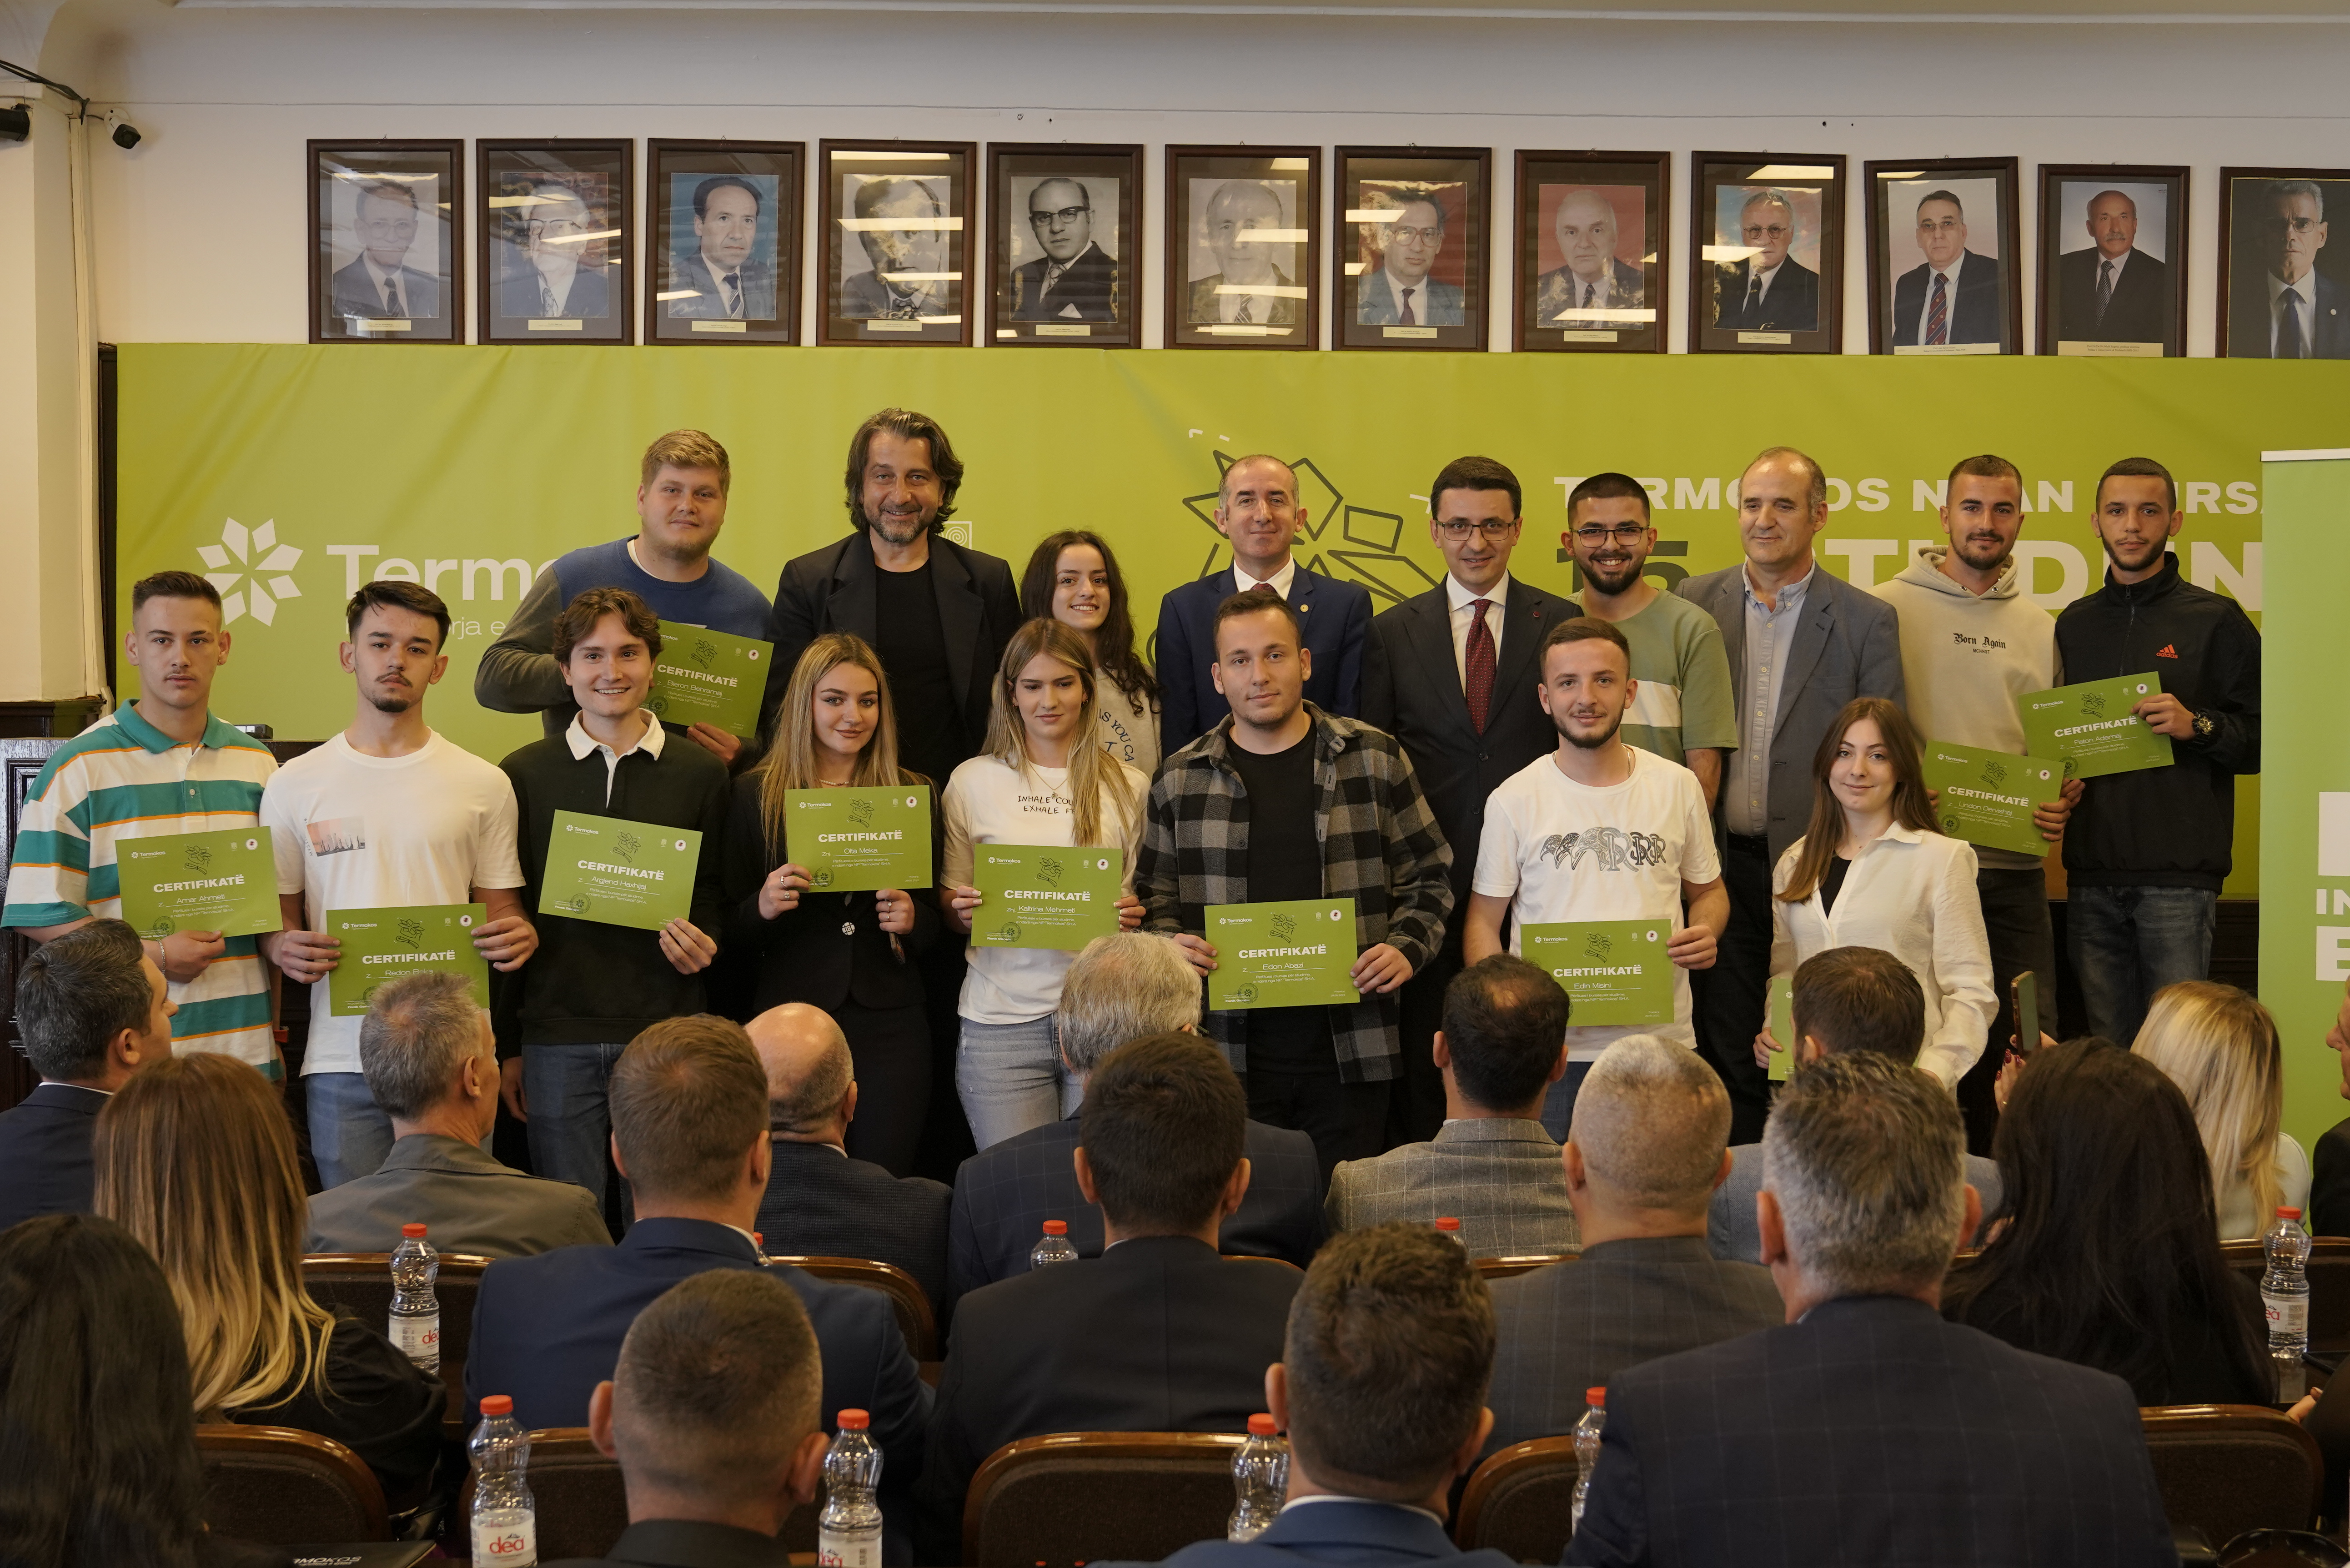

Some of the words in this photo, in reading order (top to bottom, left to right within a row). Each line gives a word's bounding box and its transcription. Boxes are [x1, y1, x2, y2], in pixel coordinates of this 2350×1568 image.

[1953, 633, 1976, 644] Born
[1982, 636, 2006, 649] Again
[657, 664, 738, 687] CERTIFIKATË
[690, 684, 723, 697] Behramaj
[2054, 715, 2137, 737] CERTIFIKATË
[1111, 720, 1131, 743] YOU
[1124, 744, 1135, 766] CA
[2094, 733, 2121, 742] Ademaj
[1018, 795, 1051, 804] INHALE
[1948, 786, 2029, 807] CERTIFIKATË
[1024, 805, 1059, 814] EXHALE
[1958, 801, 1981, 810] Lindon
[1982, 805, 2012, 816] Dervishaj
[818, 830, 903, 843] CERTIFIKATË
[577, 860, 664, 881] CERTIFIKATË
[153, 874, 245, 893] CERTIFIKATË
[591, 876, 618, 886] Argjend
[620, 880, 647, 891] Haxhijaj
[198, 893, 225, 901] Ahmeti
[1004, 890, 1090, 901] CERTIFIKATË
[362, 950, 455, 964] CERTIFIKATË
[1239, 944, 1326, 959] CERTIFIKATË
[1553, 965, 1642, 977] CERTIFIKATË
[2265, 1309, 2280, 1320] ea
[490, 1536, 524, 1553] dea
